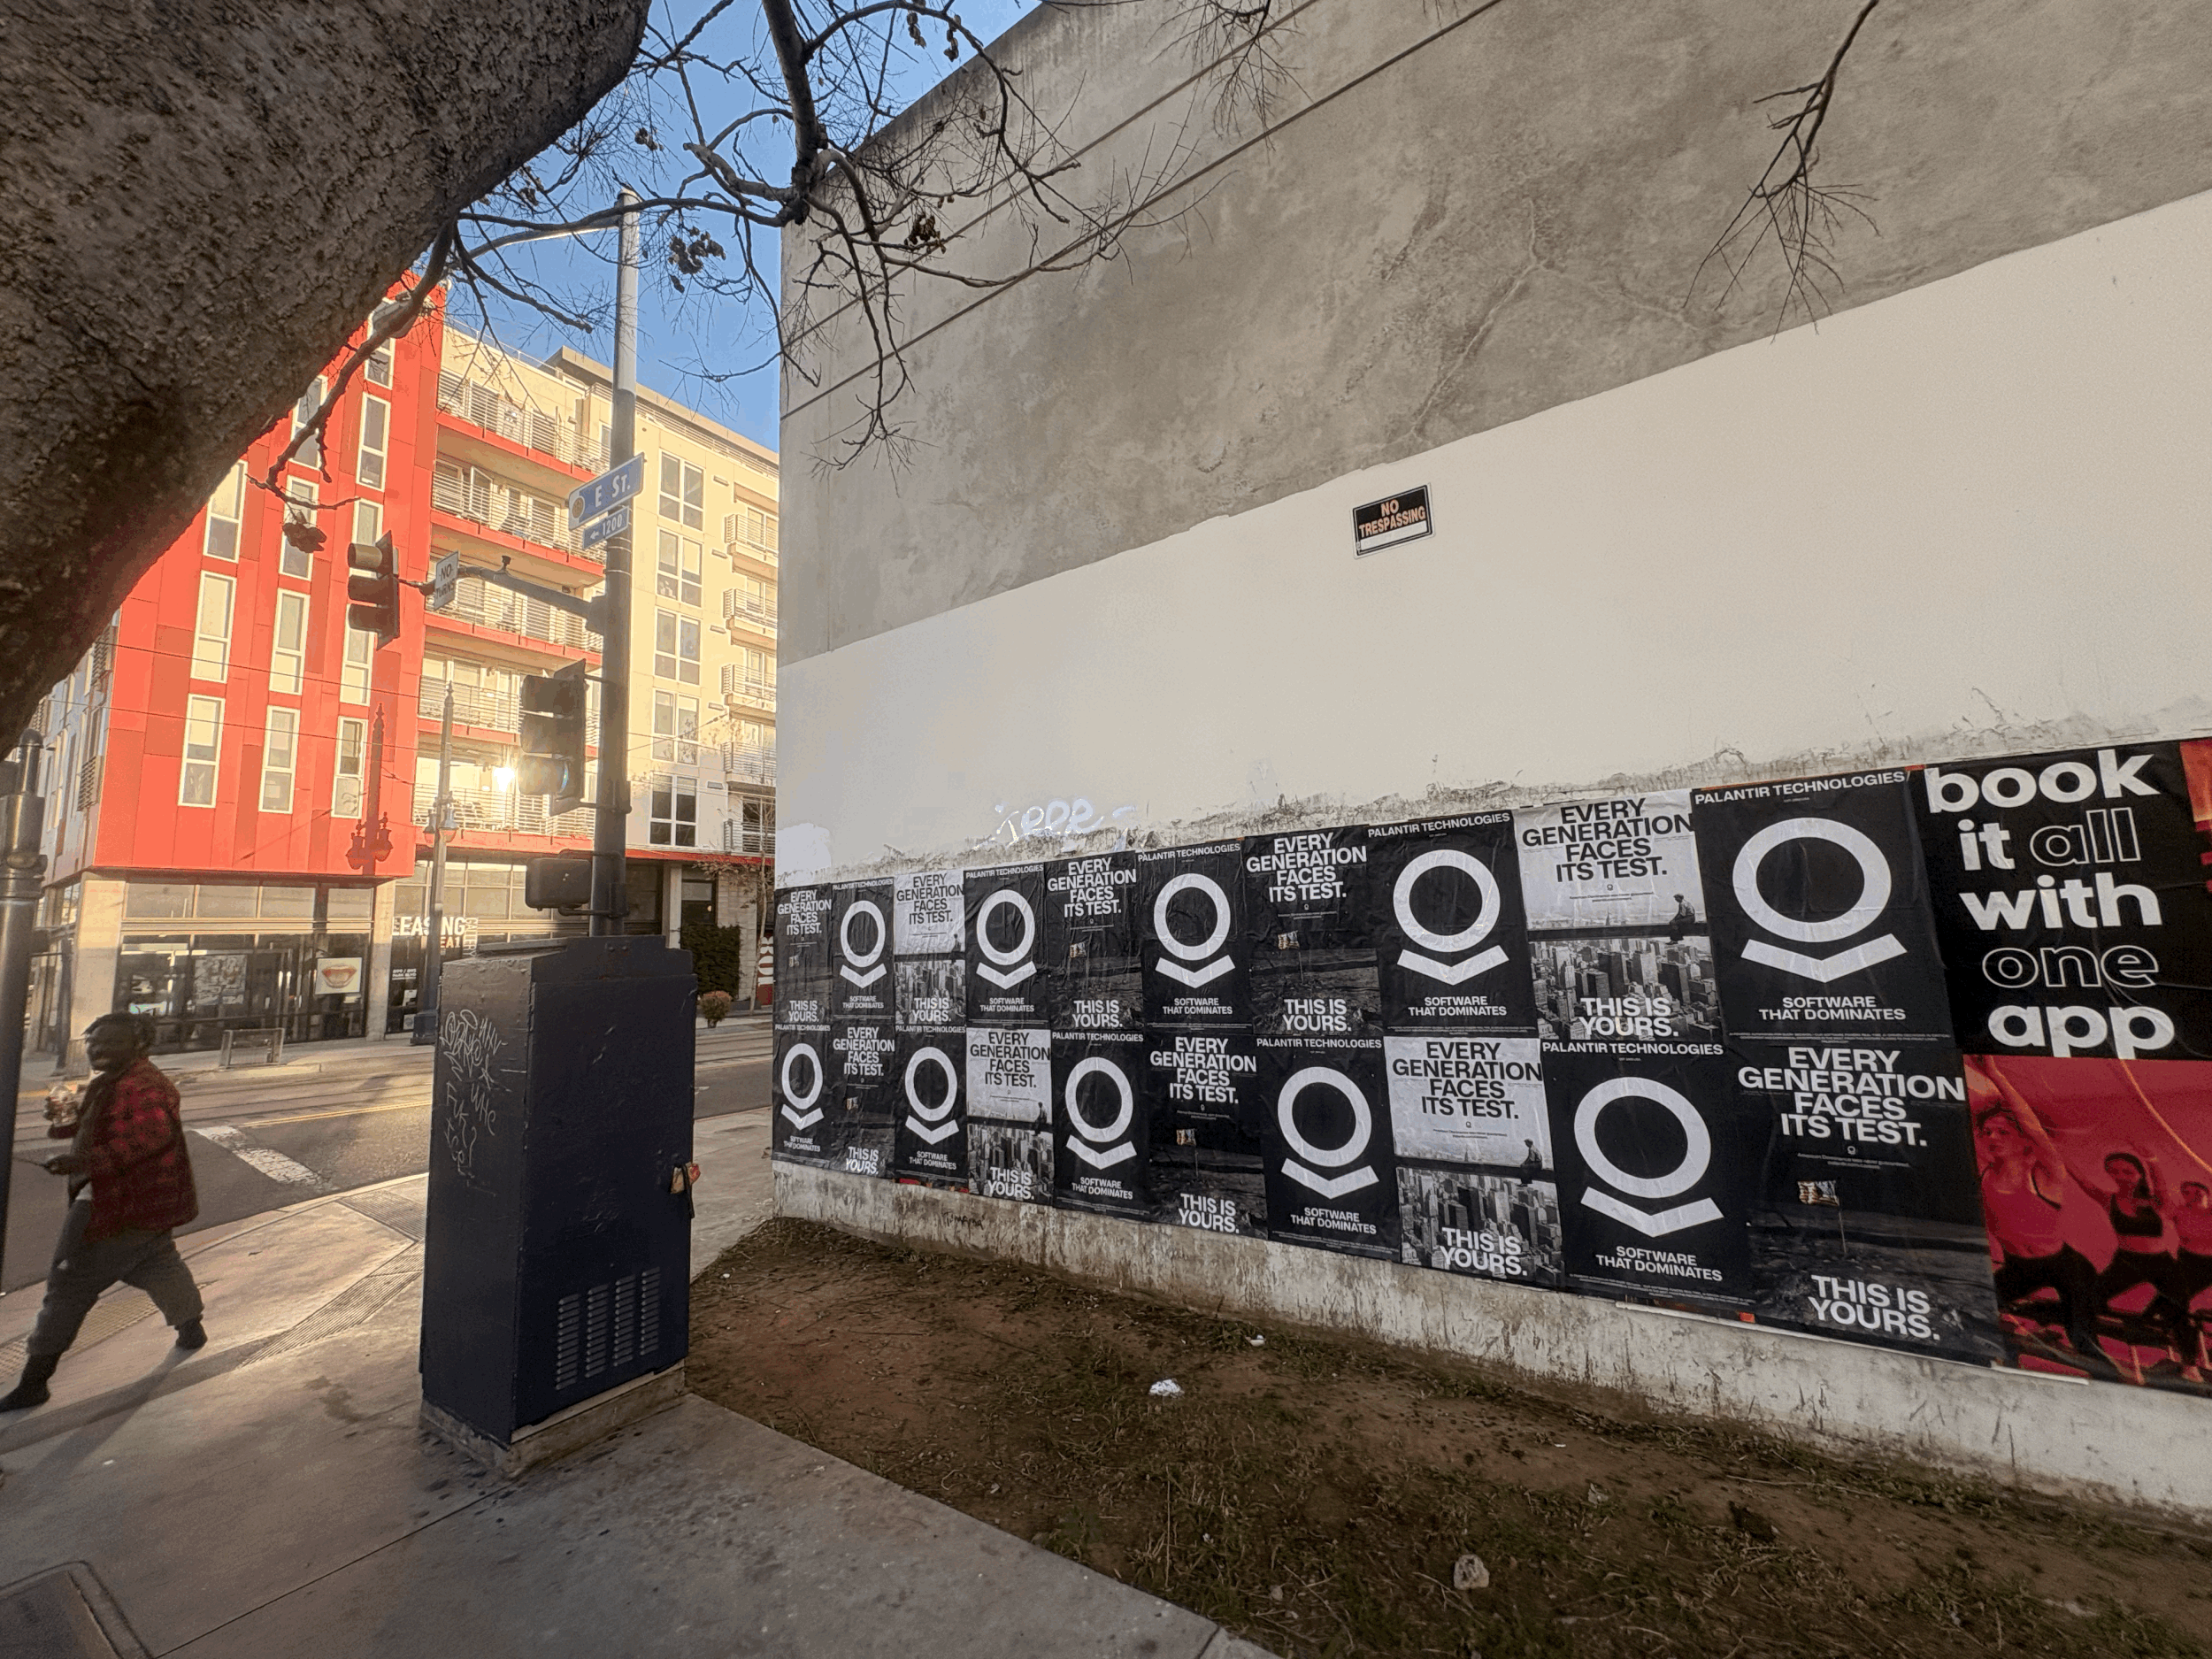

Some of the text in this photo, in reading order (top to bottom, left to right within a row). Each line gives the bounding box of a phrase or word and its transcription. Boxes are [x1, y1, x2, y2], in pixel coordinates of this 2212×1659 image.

[595, 474, 631, 508] E ST.
[1380, 499, 1399, 517] NO
[603, 514, 623, 536] 1200
[1359, 506, 1426, 538] TRESPASSING
[441, 564, 452, 581] NO
[1694, 770, 1907, 804] PALANTIR TECHNOLOGIES
[1924, 749, 2161, 813] book
[1560, 797, 1648, 824] EVERY
[1367, 811, 1511, 838] PALANTIR TECHNOLOGIES
[1521, 812, 1696, 848] GENERATION
[1273, 832, 1334, 854] EVERY
[1958, 807, 2141, 871] it all
[1138, 842, 1240, 862] PALANTIR TECHNOLOGIES
[1246, 845, 1367, 872] GENERATION
[1565, 836, 1652, 863] FACES
[966, 869, 995, 879] PALANTIR
[1068, 856, 1112, 875] EVERY
[1276, 864, 1336, 886] FACES
[1555, 856, 1667, 882] ITS TEST.
[913, 872, 947, 887] EVERY
[1047, 868, 1136, 891] GENERATION
[790, 889, 818, 902] EVERY
[896, 883, 964, 902] GENERATION
[1070, 885, 1113, 902] FACES
[1269, 880, 1347, 902] ITS TEST.
[777, 898, 831, 914] GENERATION
[913, 897, 947, 912] FACES
[1064, 898, 1121, 917] ITS TEST.
[1958, 872, 2162, 931] with
[392, 916, 465, 936] LEASNG
[790, 911, 817, 924] FACES
[909, 910, 952, 925] ITS TEST.
[787, 922, 821, 935] ITS TEST.
[1982, 945, 2159, 988] one
[789, 1000, 817, 1010] THIS IS
[913, 996, 949, 1010] THIS IS
[1073, 999, 1119, 1013] THIS IS
[1174, 997, 1219, 1006] SOFTWARE
[1284, 998, 1347, 1014] THIS IS
[1424, 995, 1487, 1006] SOFTWARE
[1579, 996, 1671, 1016] THIS IS
[1781, 995, 1878, 1008] SOFTWARE
[788, 1010, 818, 1022] YOURS.
[912, 1009, 950, 1022] YOURS.
[1071, 1013, 1122, 1027] YOURS.
[1408, 1005, 1508, 1016] THAT DOMINATES
[1758, 1008, 1908, 1020] THAT DOMINATES
[1282, 1014, 1351, 1031] YOURS.
[1578, 1016, 1678, 1036] YOURS.
[848, 1026, 879, 1039] EVERY
[989, 1031, 1029, 1045] EVERY
[1086, 1033, 1143, 1041] TECHNOLOGIES
[1988, 1005, 2175, 1060] app
[833, 1038, 895, 1051] GENERATION
[970, 1044, 1050, 1061] GENERATION
[1175, 1036, 1229, 1054] EVERY
[1256, 1038, 1383, 1048] PALANTIR TECHNOLOGIES
[1425, 1041, 1502, 1060] EVERY
[1542, 1042, 1724, 1055] PALANTIR TECHNOLOGIES
[848, 1050, 879, 1064] FACES
[989, 1057, 1029, 1073] FACES
[1149, 1050, 1257, 1071] GENERATION
[1787, 1046, 1903, 1073] EVERY
[844, 1062, 883, 1076] ITS TEST.
[1176, 1067, 1230, 1087] FACES
[1391, 1058, 1544, 1081] GENERATION
[984, 1071, 1035, 1087] ITS TEST.
[1429, 1078, 1506, 1099] FACES
[1737, 1066, 1966, 1101] GENERATION
[1170, 1082, 1238, 1103] ITS TEST.
[1421, 1095, 1518, 1119] ITS TEST.
[1793, 1091, 1908, 1121] FACES
[1780, 1113, 1927, 1146] ITS TEST.
[847, 1146, 879, 1162] THIS IS
[917, 1150, 947, 1161] SOFTWARE
[846, 1157, 880, 1175] YOURS.
[924, 1158, 956, 1170] DOMINATES
[990, 1166, 1032, 1186] THIS IS
[1081, 1176, 1121, 1189] SOFTWARE
[988, 1179, 1034, 1200] YOURS.
[1071, 1182, 1133, 1200] THAT DOMINATES
[1179, 1193, 1235, 1217] THIS IS
[1304, 1206, 1360, 1222] SOFTWARE
[1178, 1208, 1239, 1233] YOURS.
[1290, 1214, 1377, 1234] THAT DOMINATES
[1441, 1227, 1521, 1256] THIS IS
[1440, 1245, 1527, 1277] YOURS.
[1616, 1245, 1698, 1266] SOFTWARE
[1595, 1254, 1724, 1282] THAT DOMINATES
[1810, 1274, 1931, 1315] THIS IS
[1808, 1296, 1940, 1340] YOURS.
